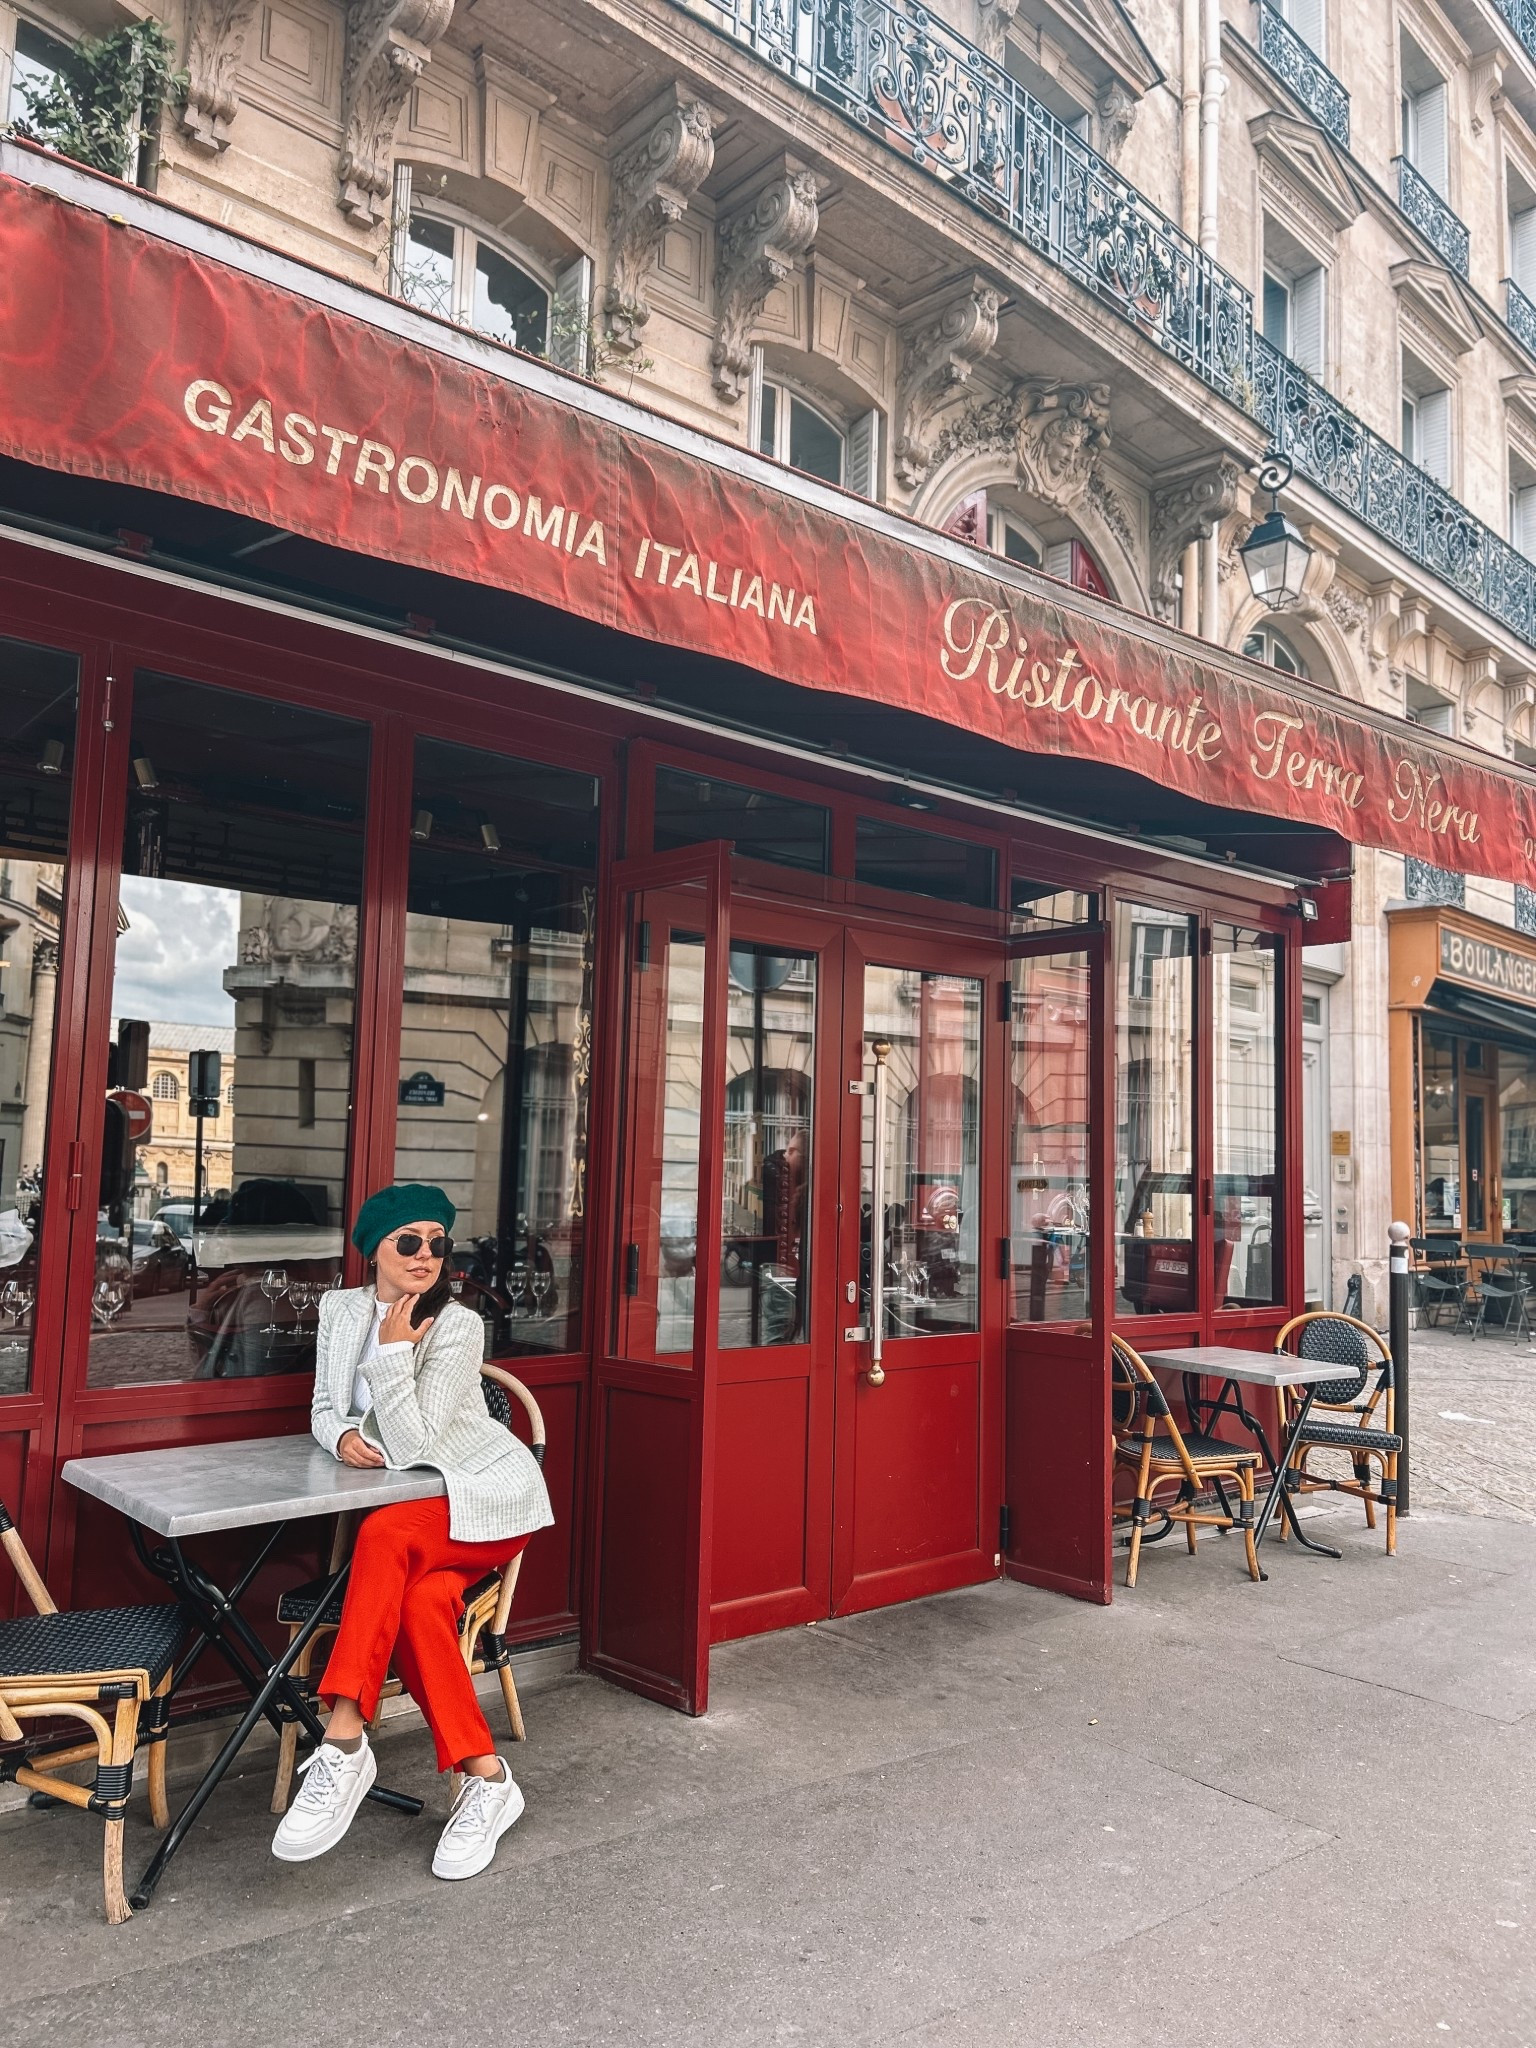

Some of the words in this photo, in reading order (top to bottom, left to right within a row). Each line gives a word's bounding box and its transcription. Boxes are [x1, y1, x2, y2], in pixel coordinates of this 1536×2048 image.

[183, 378, 608, 567] GASTRONOMIA
[634, 536, 819, 636] ITALIANA
[940, 596, 1223, 763] Ristorante
[1250, 710, 1365, 809] Terra
[1386, 758, 1482, 845] Nera
